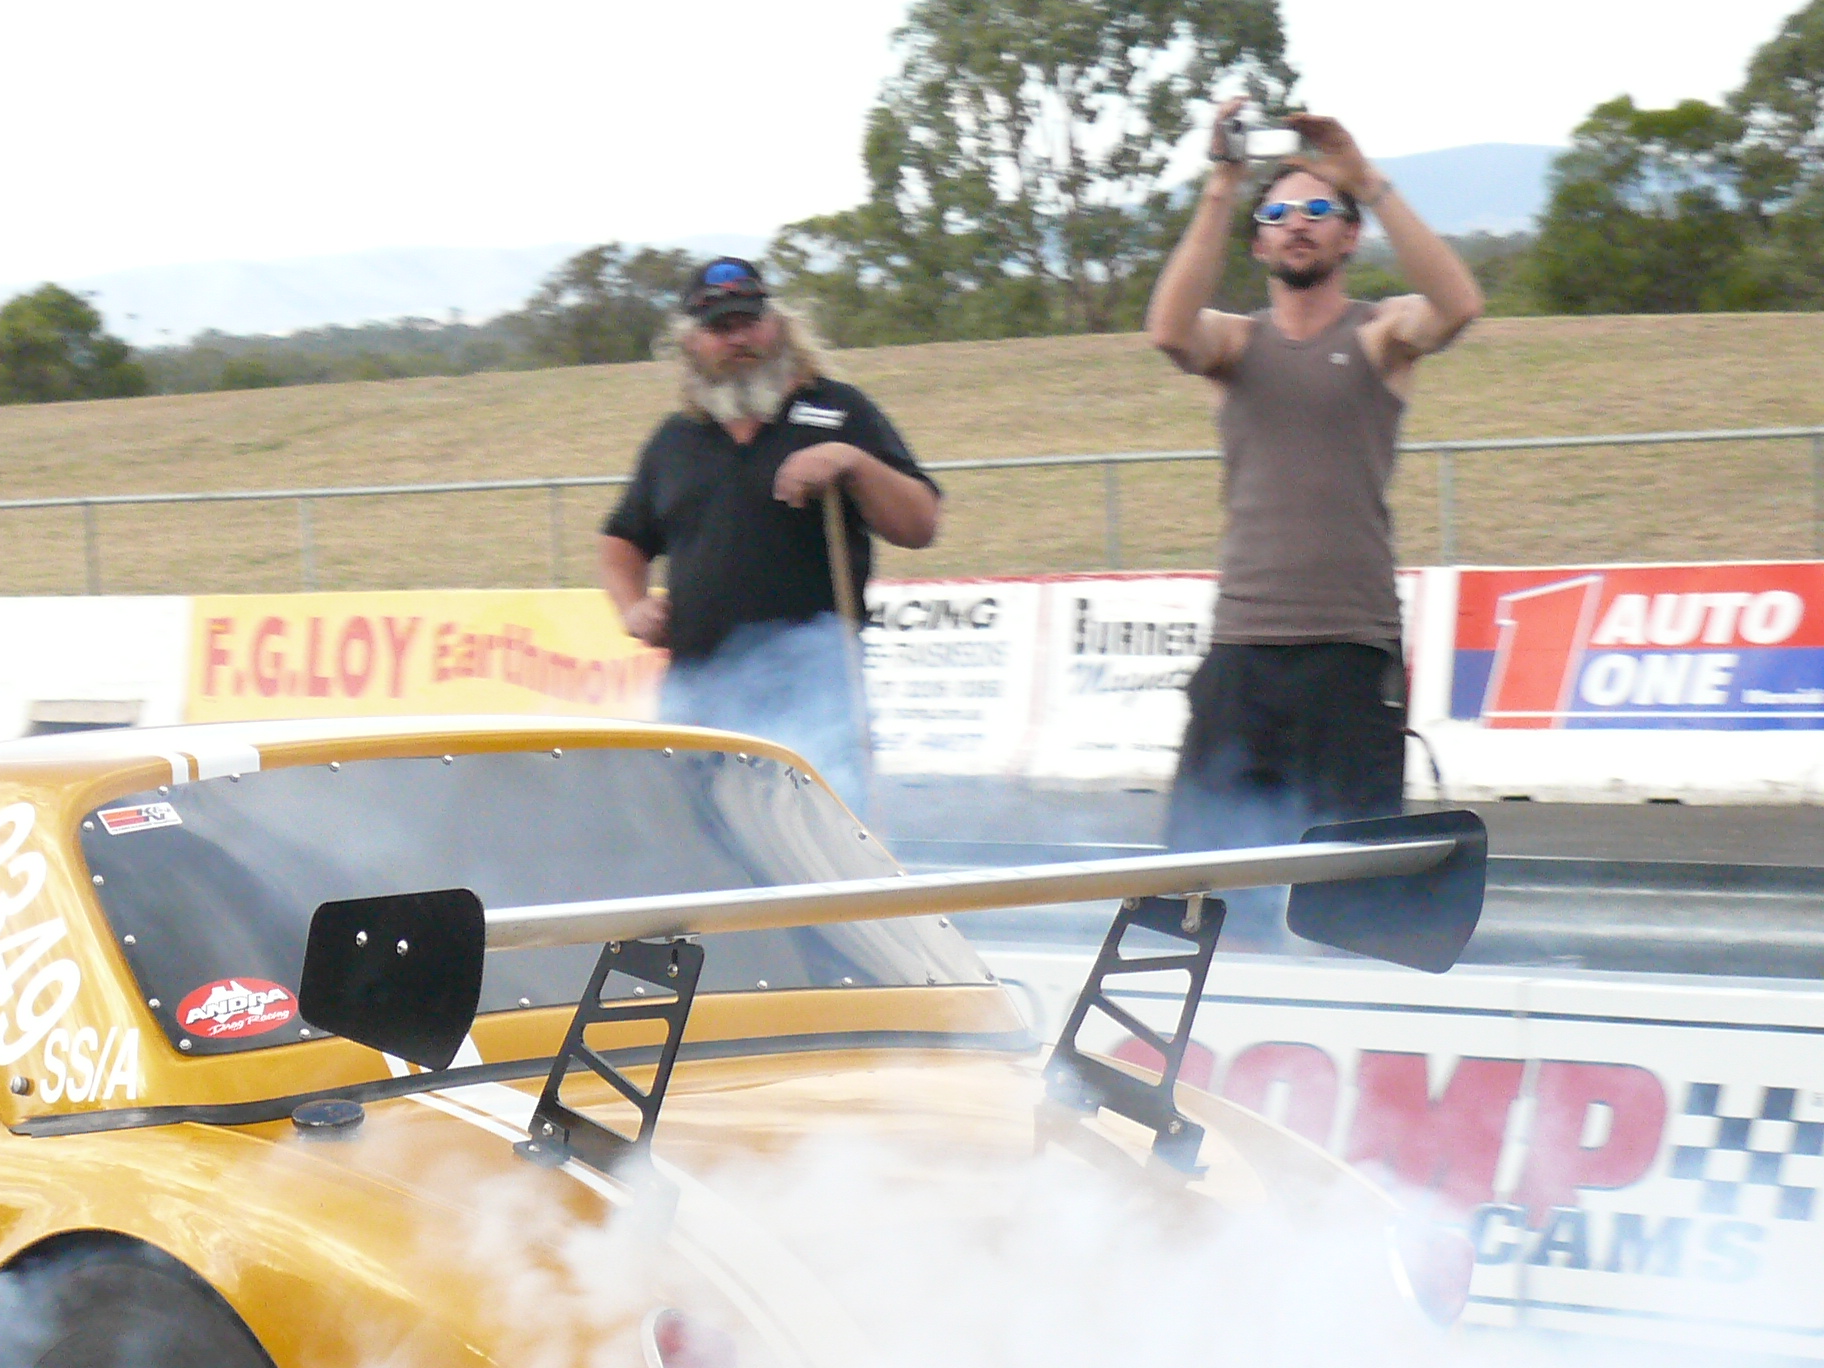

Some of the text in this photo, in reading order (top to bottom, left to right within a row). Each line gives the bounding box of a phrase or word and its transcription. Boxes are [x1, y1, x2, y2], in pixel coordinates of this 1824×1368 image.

[866, 597, 999, 631] ACING
[1590, 590, 1804, 645] AUTO
[1580, 653, 1740, 706] ONE
[185, 988, 289, 1024] ANDRA
[40, 1028, 141, 1104] SS/A
[1474, 1204, 1768, 1284] CAMS
